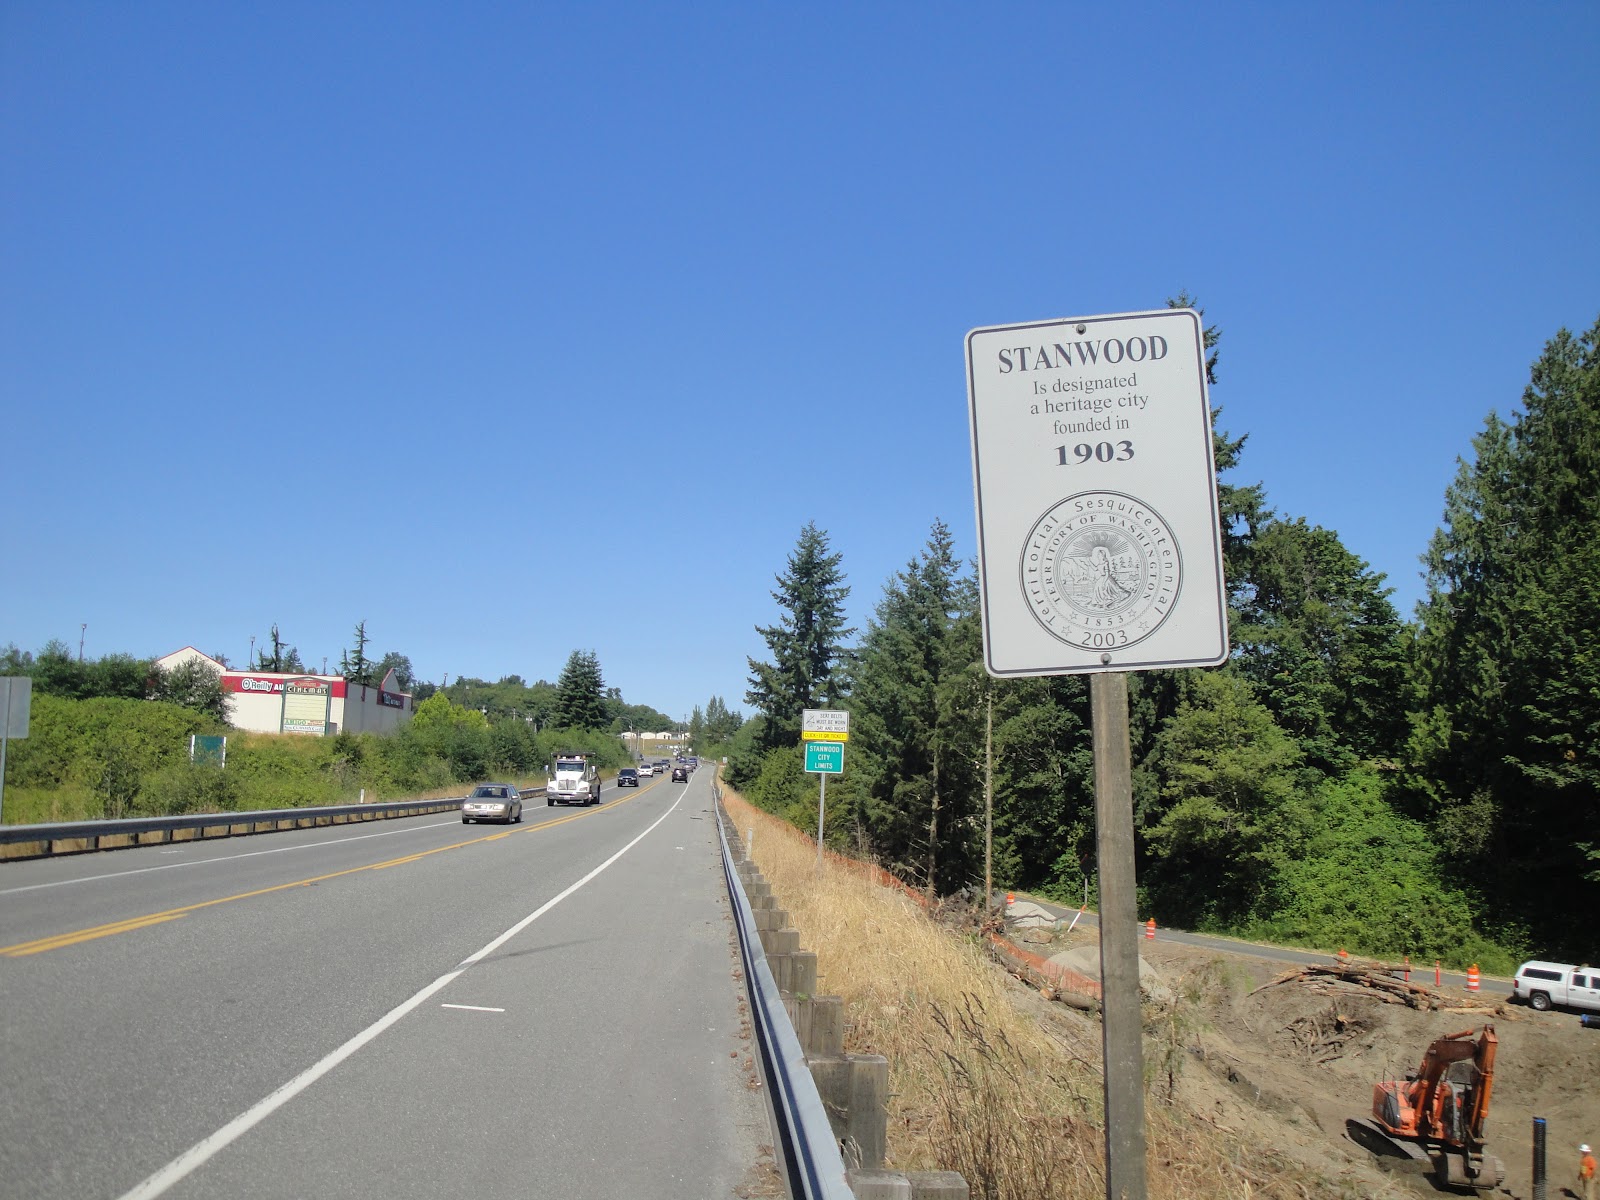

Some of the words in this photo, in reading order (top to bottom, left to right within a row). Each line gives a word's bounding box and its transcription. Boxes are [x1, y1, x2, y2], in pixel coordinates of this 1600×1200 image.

[998, 335, 1168, 374] STANWOOD
[1033, 380, 1047, 395] Is
[1052, 372, 1138, 394] designated
[1030, 404, 1039, 415] a
[1045, 396, 1112, 414] heritage
[1117, 392, 1149, 410] city
[1053, 416, 1111, 435] founded
[1116, 415, 1129, 430] in
[1054, 440, 1135, 467] 1903
[1028, 515, 1059, 626] Territorial
[1074, 499, 1173, 615] Sesquicentennial
[1044, 523, 1074, 603] TERRITORY
[1079, 514, 1097, 525] OF
[1108, 515, 1157, 600] WASHINGTON
[1084, 616, 1124, 626] 1853
[1081, 629, 1128, 647] 2003
[242, 678, 272, 692] O'Reilly
[274, 683, 283, 691] AU
